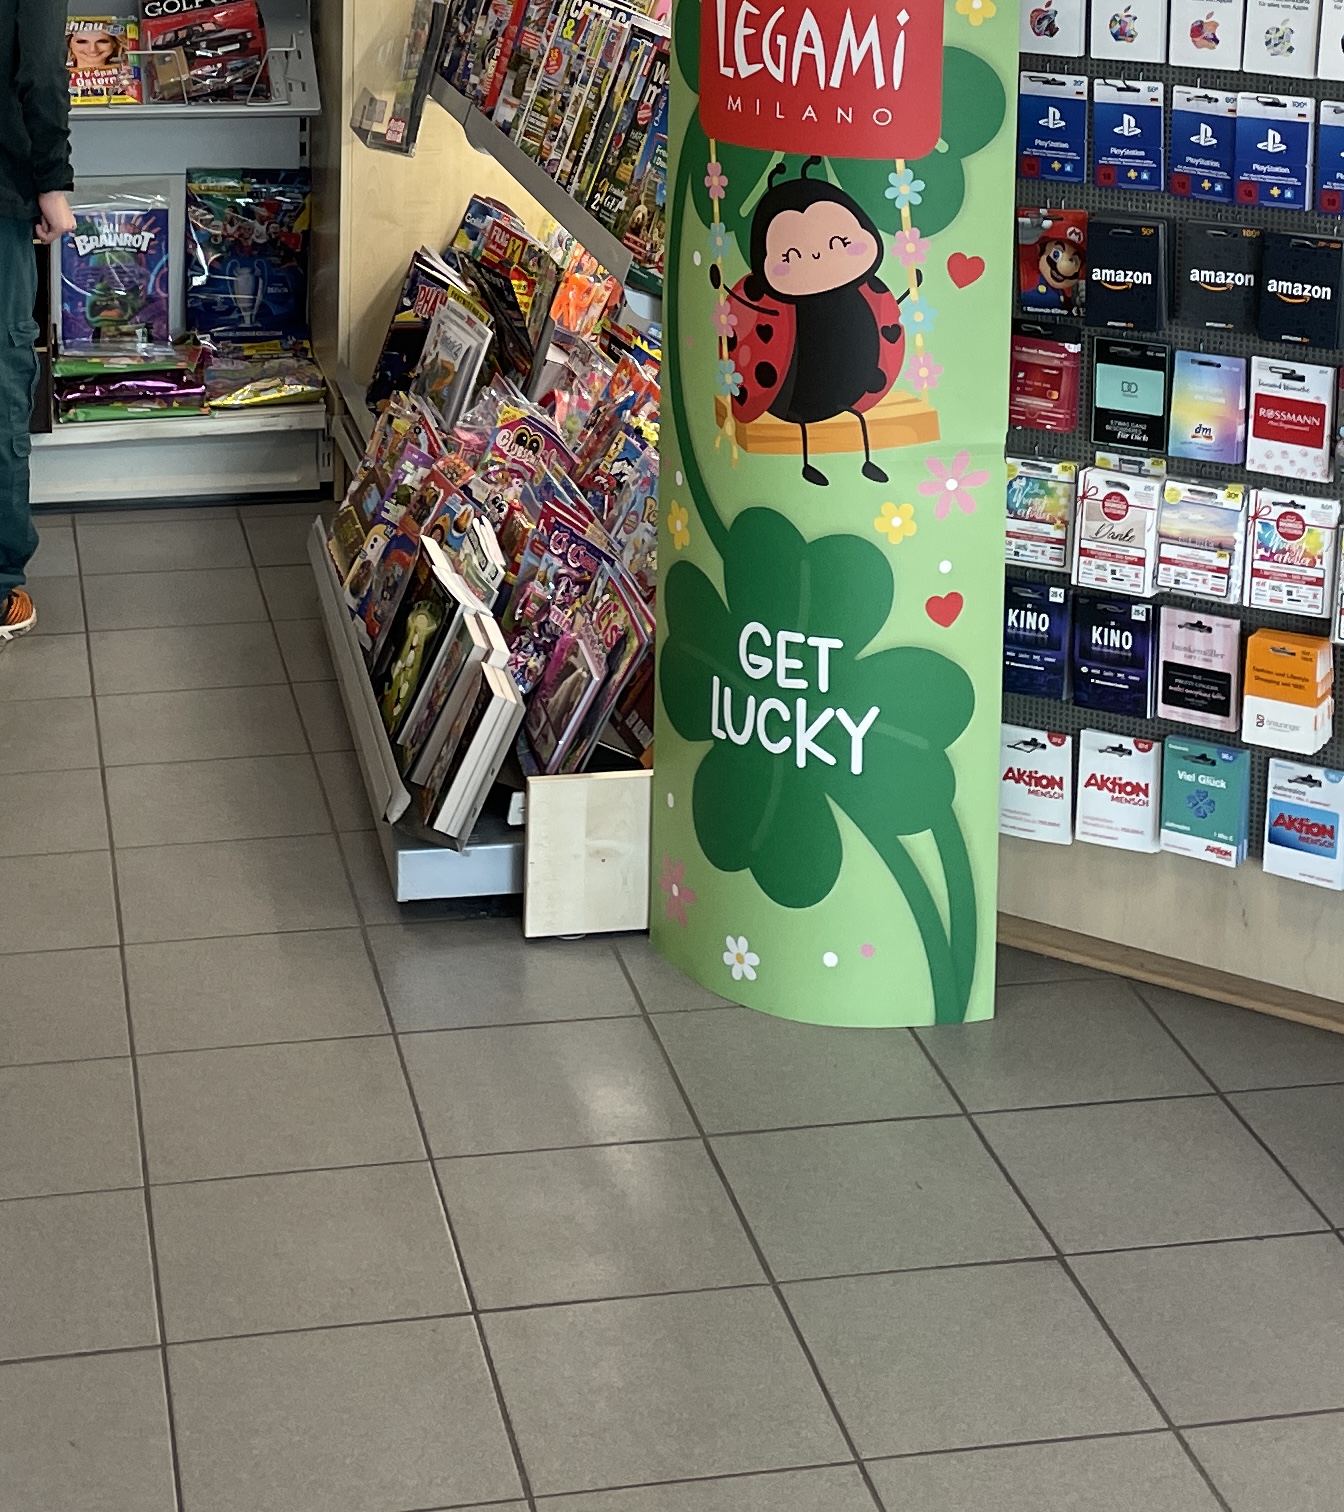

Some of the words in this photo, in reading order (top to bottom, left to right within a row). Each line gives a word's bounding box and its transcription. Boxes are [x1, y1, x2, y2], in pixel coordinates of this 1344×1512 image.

[727, 94, 893, 126] MILANO
[1091, 268, 1153, 287] amazon
[1189, 266, 1254, 288] amazon
[1266, 278, 1332, 300] amazon
[1258, 407, 1321, 427] ROSSMANN
[1008, 608, 1050, 633] KINO
[1091, 625, 1133, 651] KINO
[738, 621, 844, 693] GET
[711, 675, 880, 776] LUCKY
